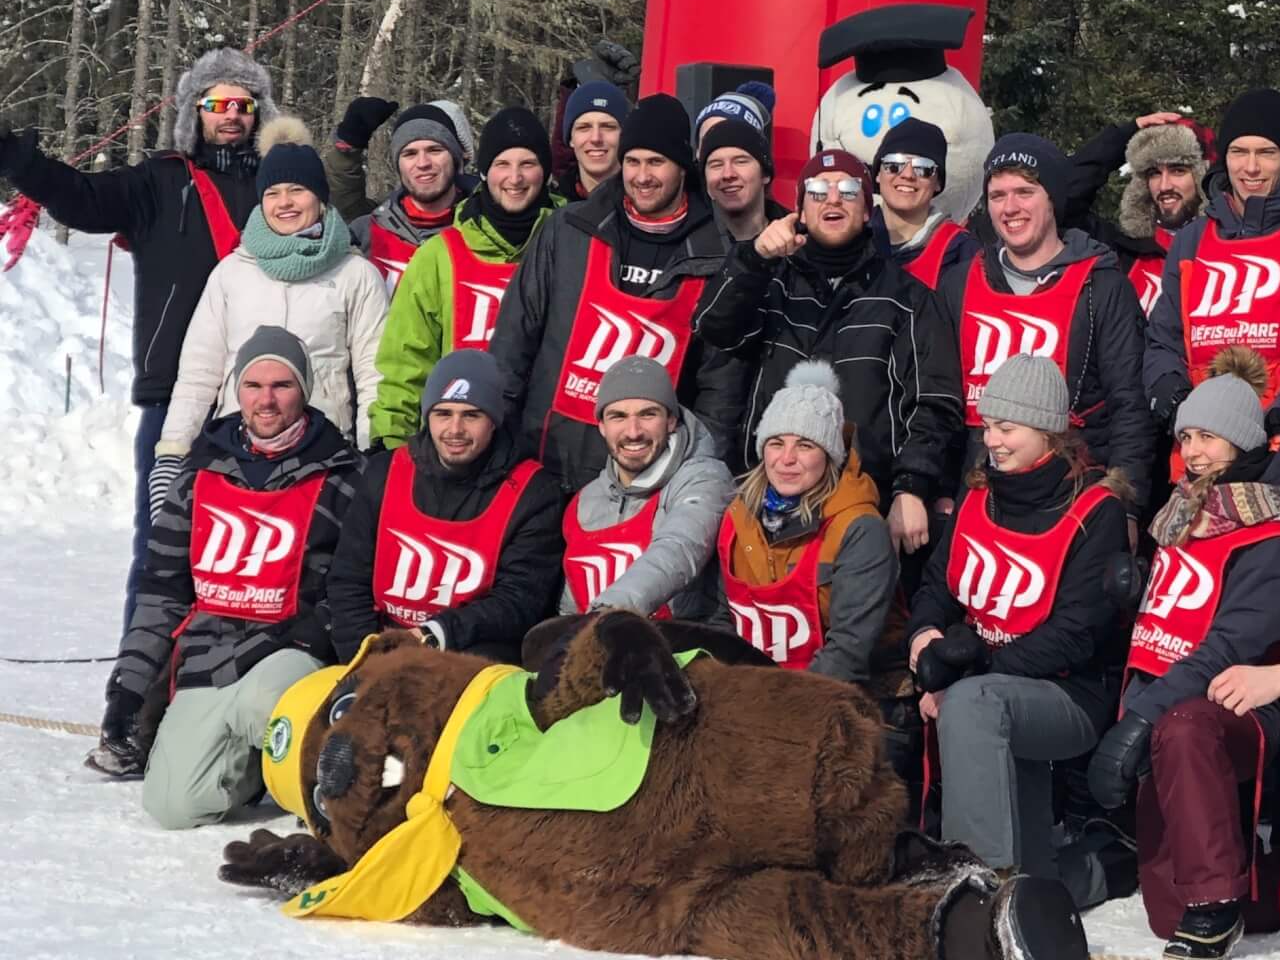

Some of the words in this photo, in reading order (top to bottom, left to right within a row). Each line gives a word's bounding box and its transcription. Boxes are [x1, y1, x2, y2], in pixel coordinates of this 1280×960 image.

[572, 302, 677, 373] DP
[966, 310, 1059, 375] DP
[1235, 320, 1280, 338] PARC
[193, 503, 296, 576] DP
[383, 528, 486, 606] DP
[242, 583, 287, 602] PARC
[957, 532, 1046, 620] DP
[1150, 622, 1194, 657] PARC
